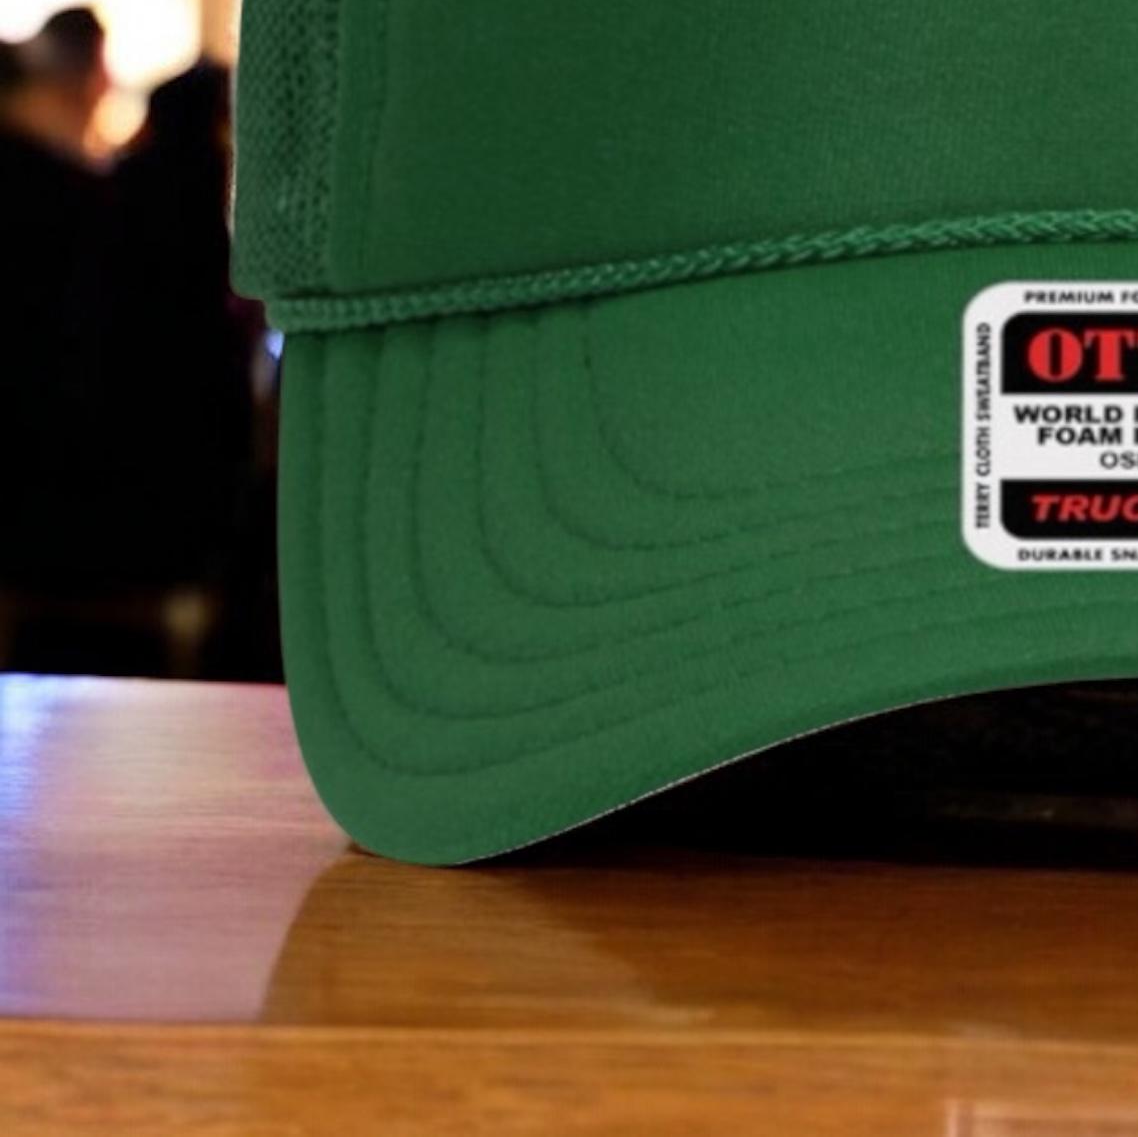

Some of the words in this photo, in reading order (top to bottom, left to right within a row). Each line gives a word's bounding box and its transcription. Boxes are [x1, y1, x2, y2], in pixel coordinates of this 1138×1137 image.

[1024, 291, 1114, 303] PREMIUM
[976, 323, 991, 421] SWEATBAND
[1015, 405, 1123, 424] WORLD
[1038, 427, 1122, 445] FOAM
[976, 427, 991, 477] CLOTH
[976, 483, 990, 528] TERRY
[1018, 548, 1102, 561] DURABLE
